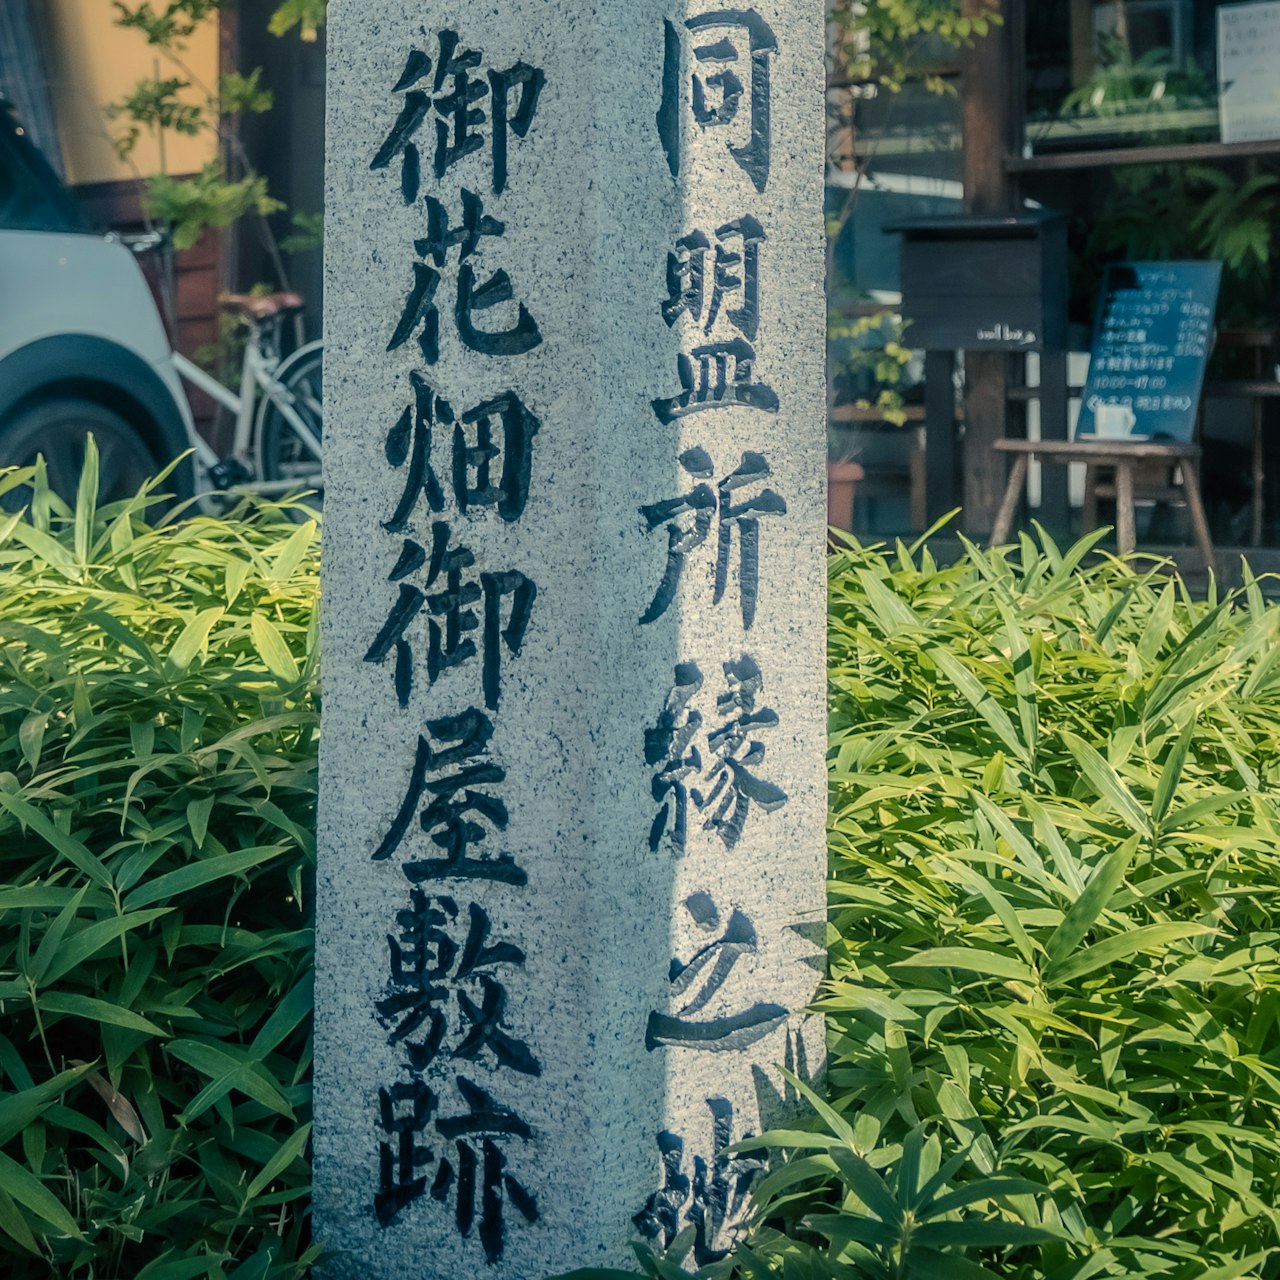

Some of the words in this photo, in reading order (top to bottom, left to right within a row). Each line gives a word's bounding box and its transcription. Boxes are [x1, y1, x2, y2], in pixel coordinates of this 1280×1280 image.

[364, 28, 547, 1265] 御花畑御屋敷跡
